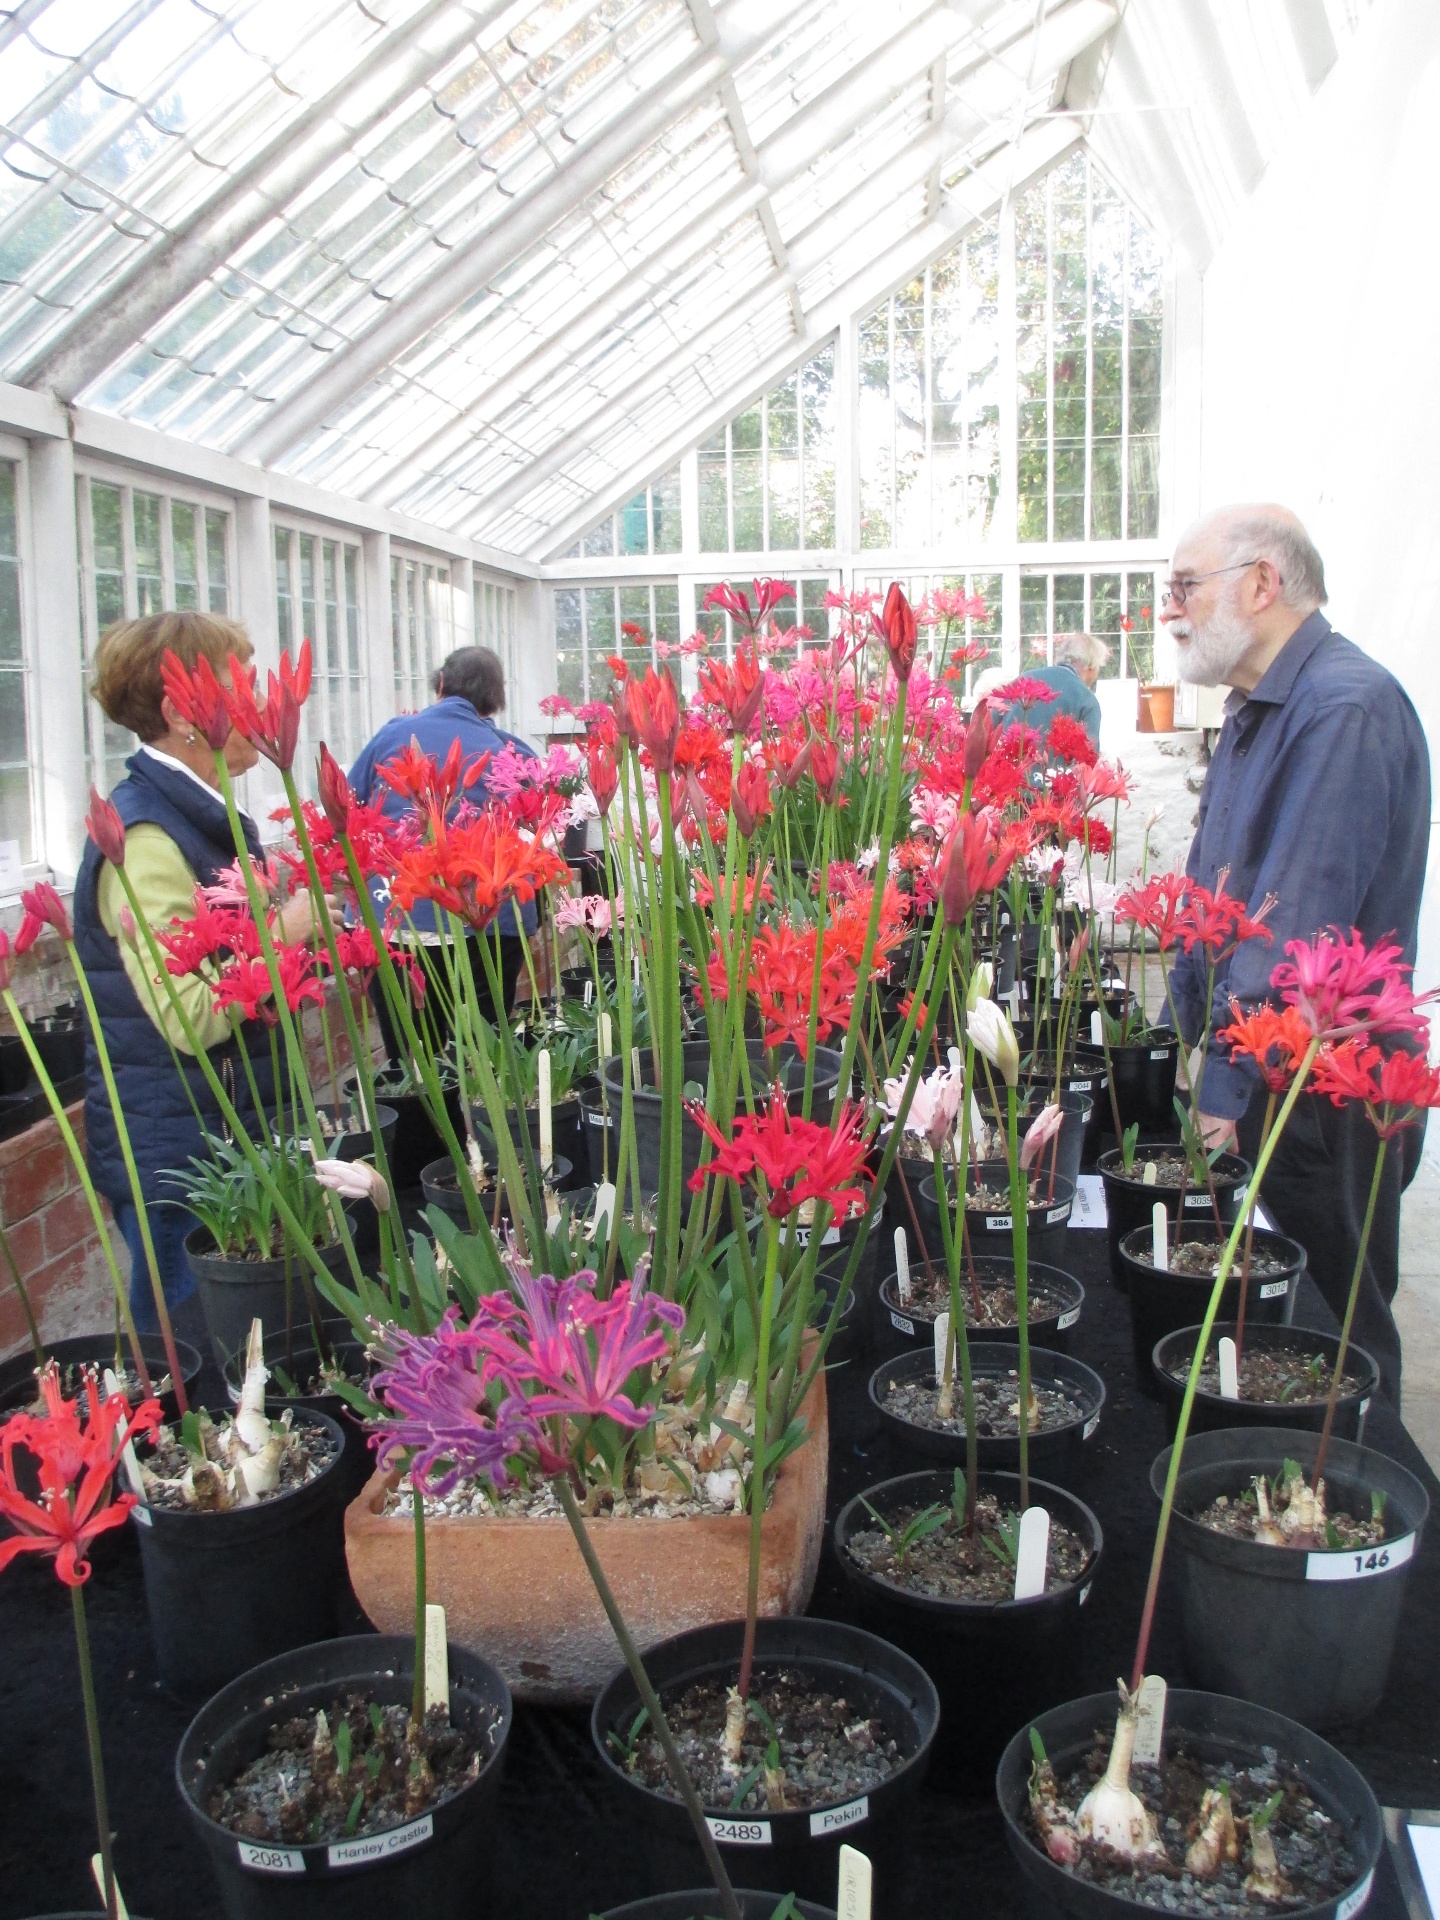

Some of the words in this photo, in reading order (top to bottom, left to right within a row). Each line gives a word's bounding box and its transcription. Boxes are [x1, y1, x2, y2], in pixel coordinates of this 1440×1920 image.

[993, 1219, 1009, 1227] 386
[1266, 1282, 1286, 1296] 3012
[1354, 1549, 1390, 1572] 146
[824, 1805, 863, 1828] Pekin
[714, 1823, 763, 1840] 2489
[337, 1841, 384, 1860] Hanley
[388, 1824, 429, 1847] Castle
[251, 1849, 293, 1868] 2081
